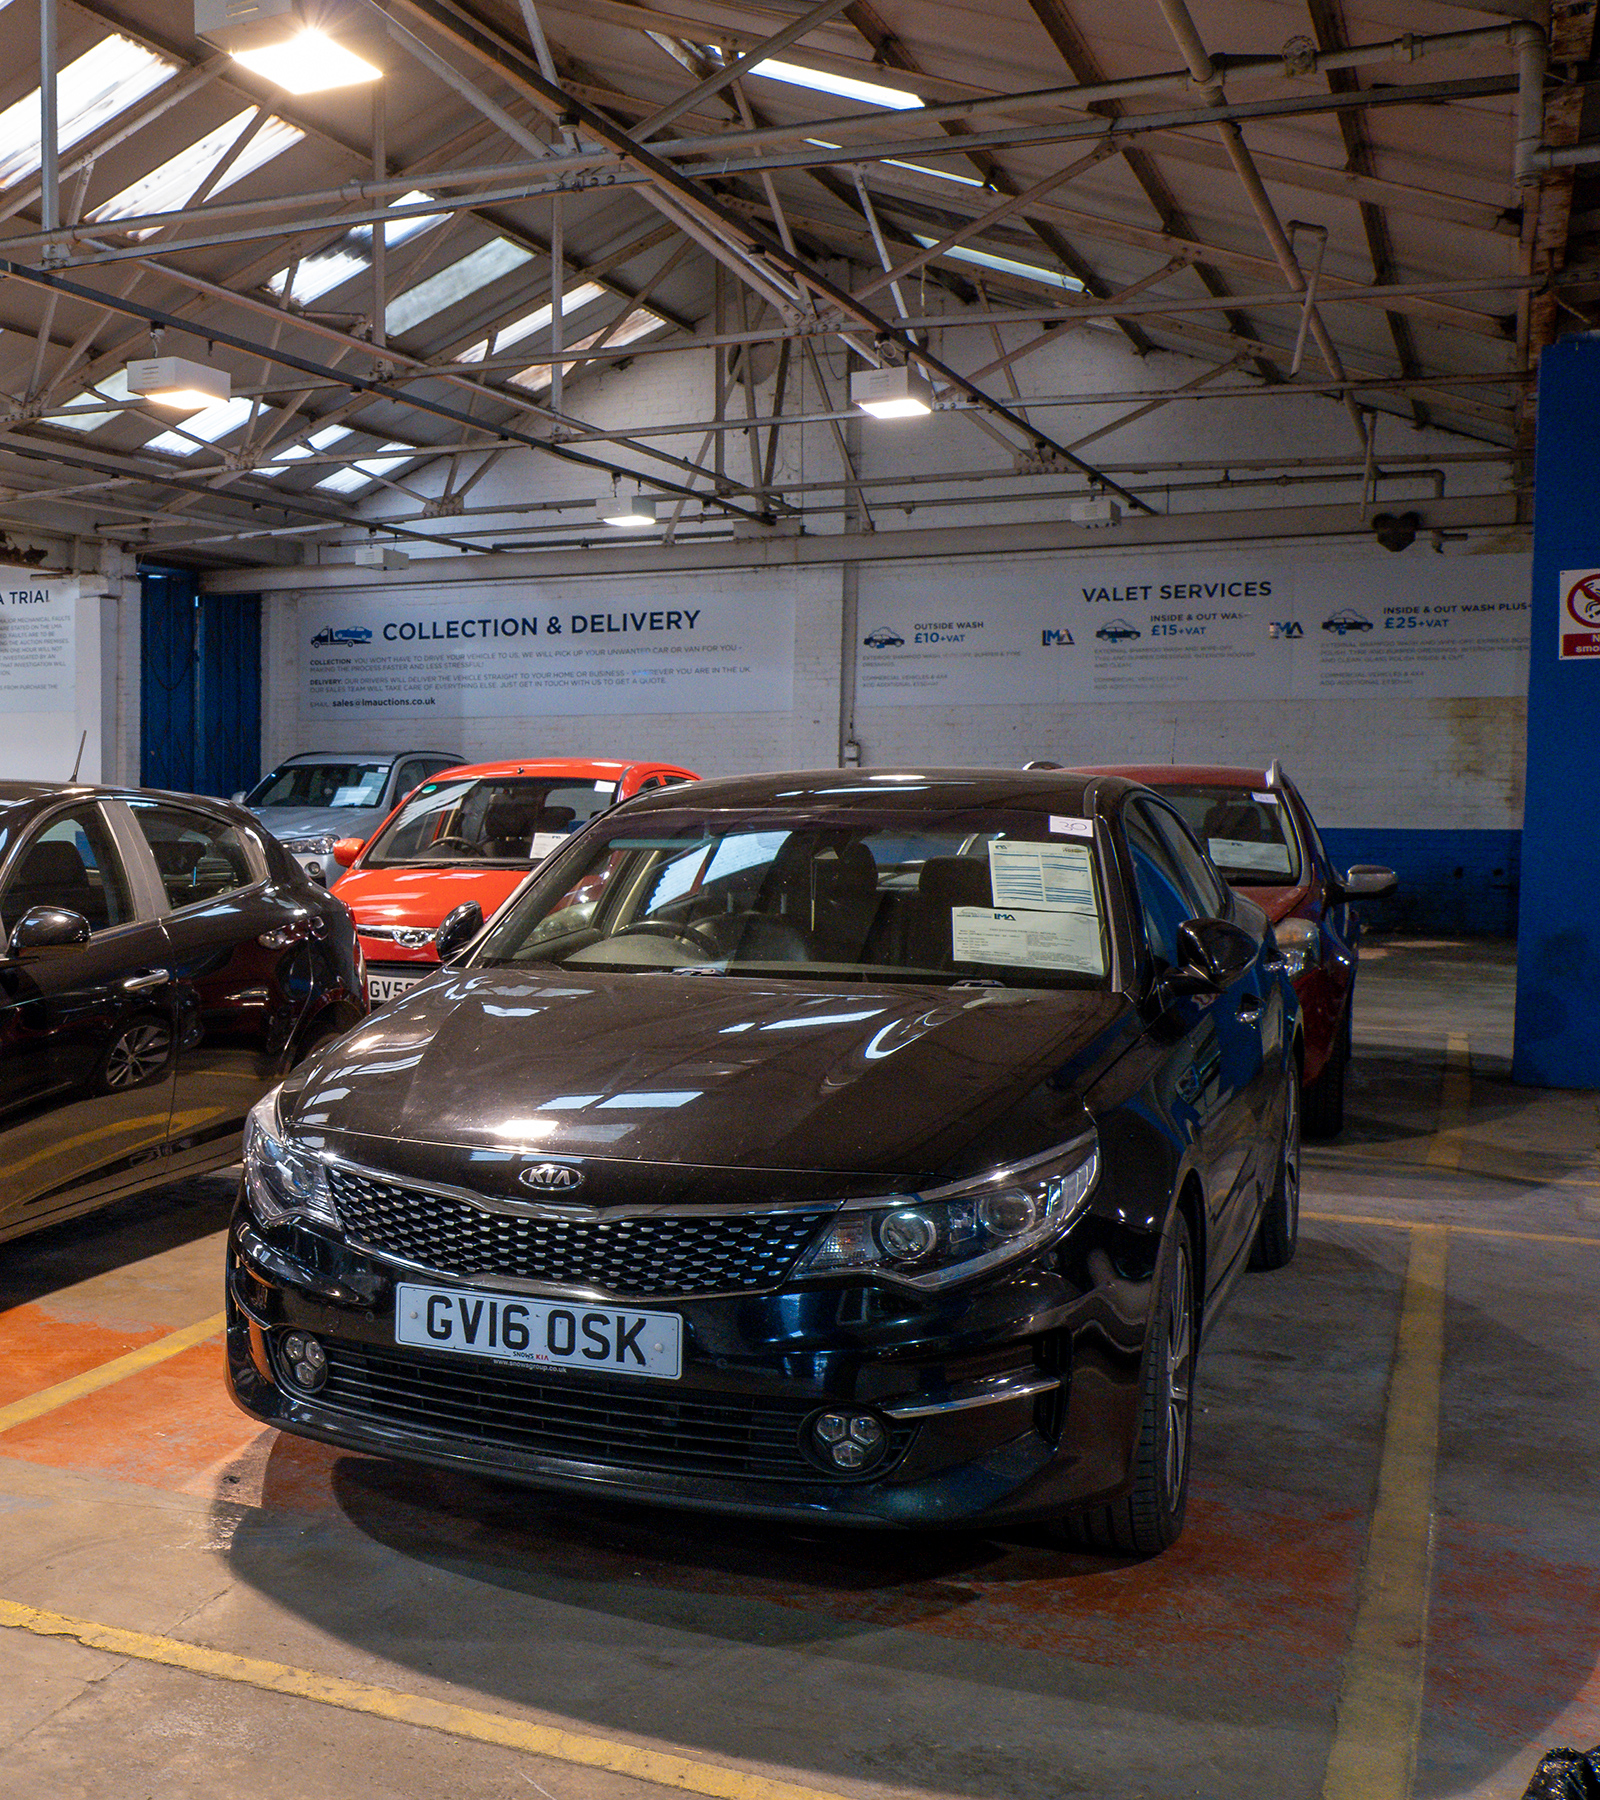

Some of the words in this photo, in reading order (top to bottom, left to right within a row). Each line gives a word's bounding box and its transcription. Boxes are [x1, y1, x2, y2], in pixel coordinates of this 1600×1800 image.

[9, 590, 50, 604] TRIAL
[1082, 586, 1152, 602] VALET
[1160, 582, 1272, 600] SERVICES
[1462, 604, 1495, 612] WASH
[1150, 614, 1184, 622] INSIDE
[1384, 617, 1448, 629] £25+VAT
[382, 616, 538, 641] COLLECTION
[546, 616, 562, 634] &
[571, 610, 700, 634] DELIVERY
[1151, 624, 1206, 636] £15+VAT
[914, 632, 966, 644] £10+VAT
[1042, 628, 1075, 646] LMA
[1575, 645, 1600, 653] smo
[1058, 821, 1087, 832] 30
[994, 913, 1016, 922] LMA
[370, 980, 414, 998] GV5
[528, 1167, 572, 1186] KIA
[426, 1294, 530, 1351] GV16
[547, 1309, 646, 1366] OSK
[512, 1351, 534, 1360] SNOWS
[493, 1358, 567, 1374] www.snowsgroup.co.uk
